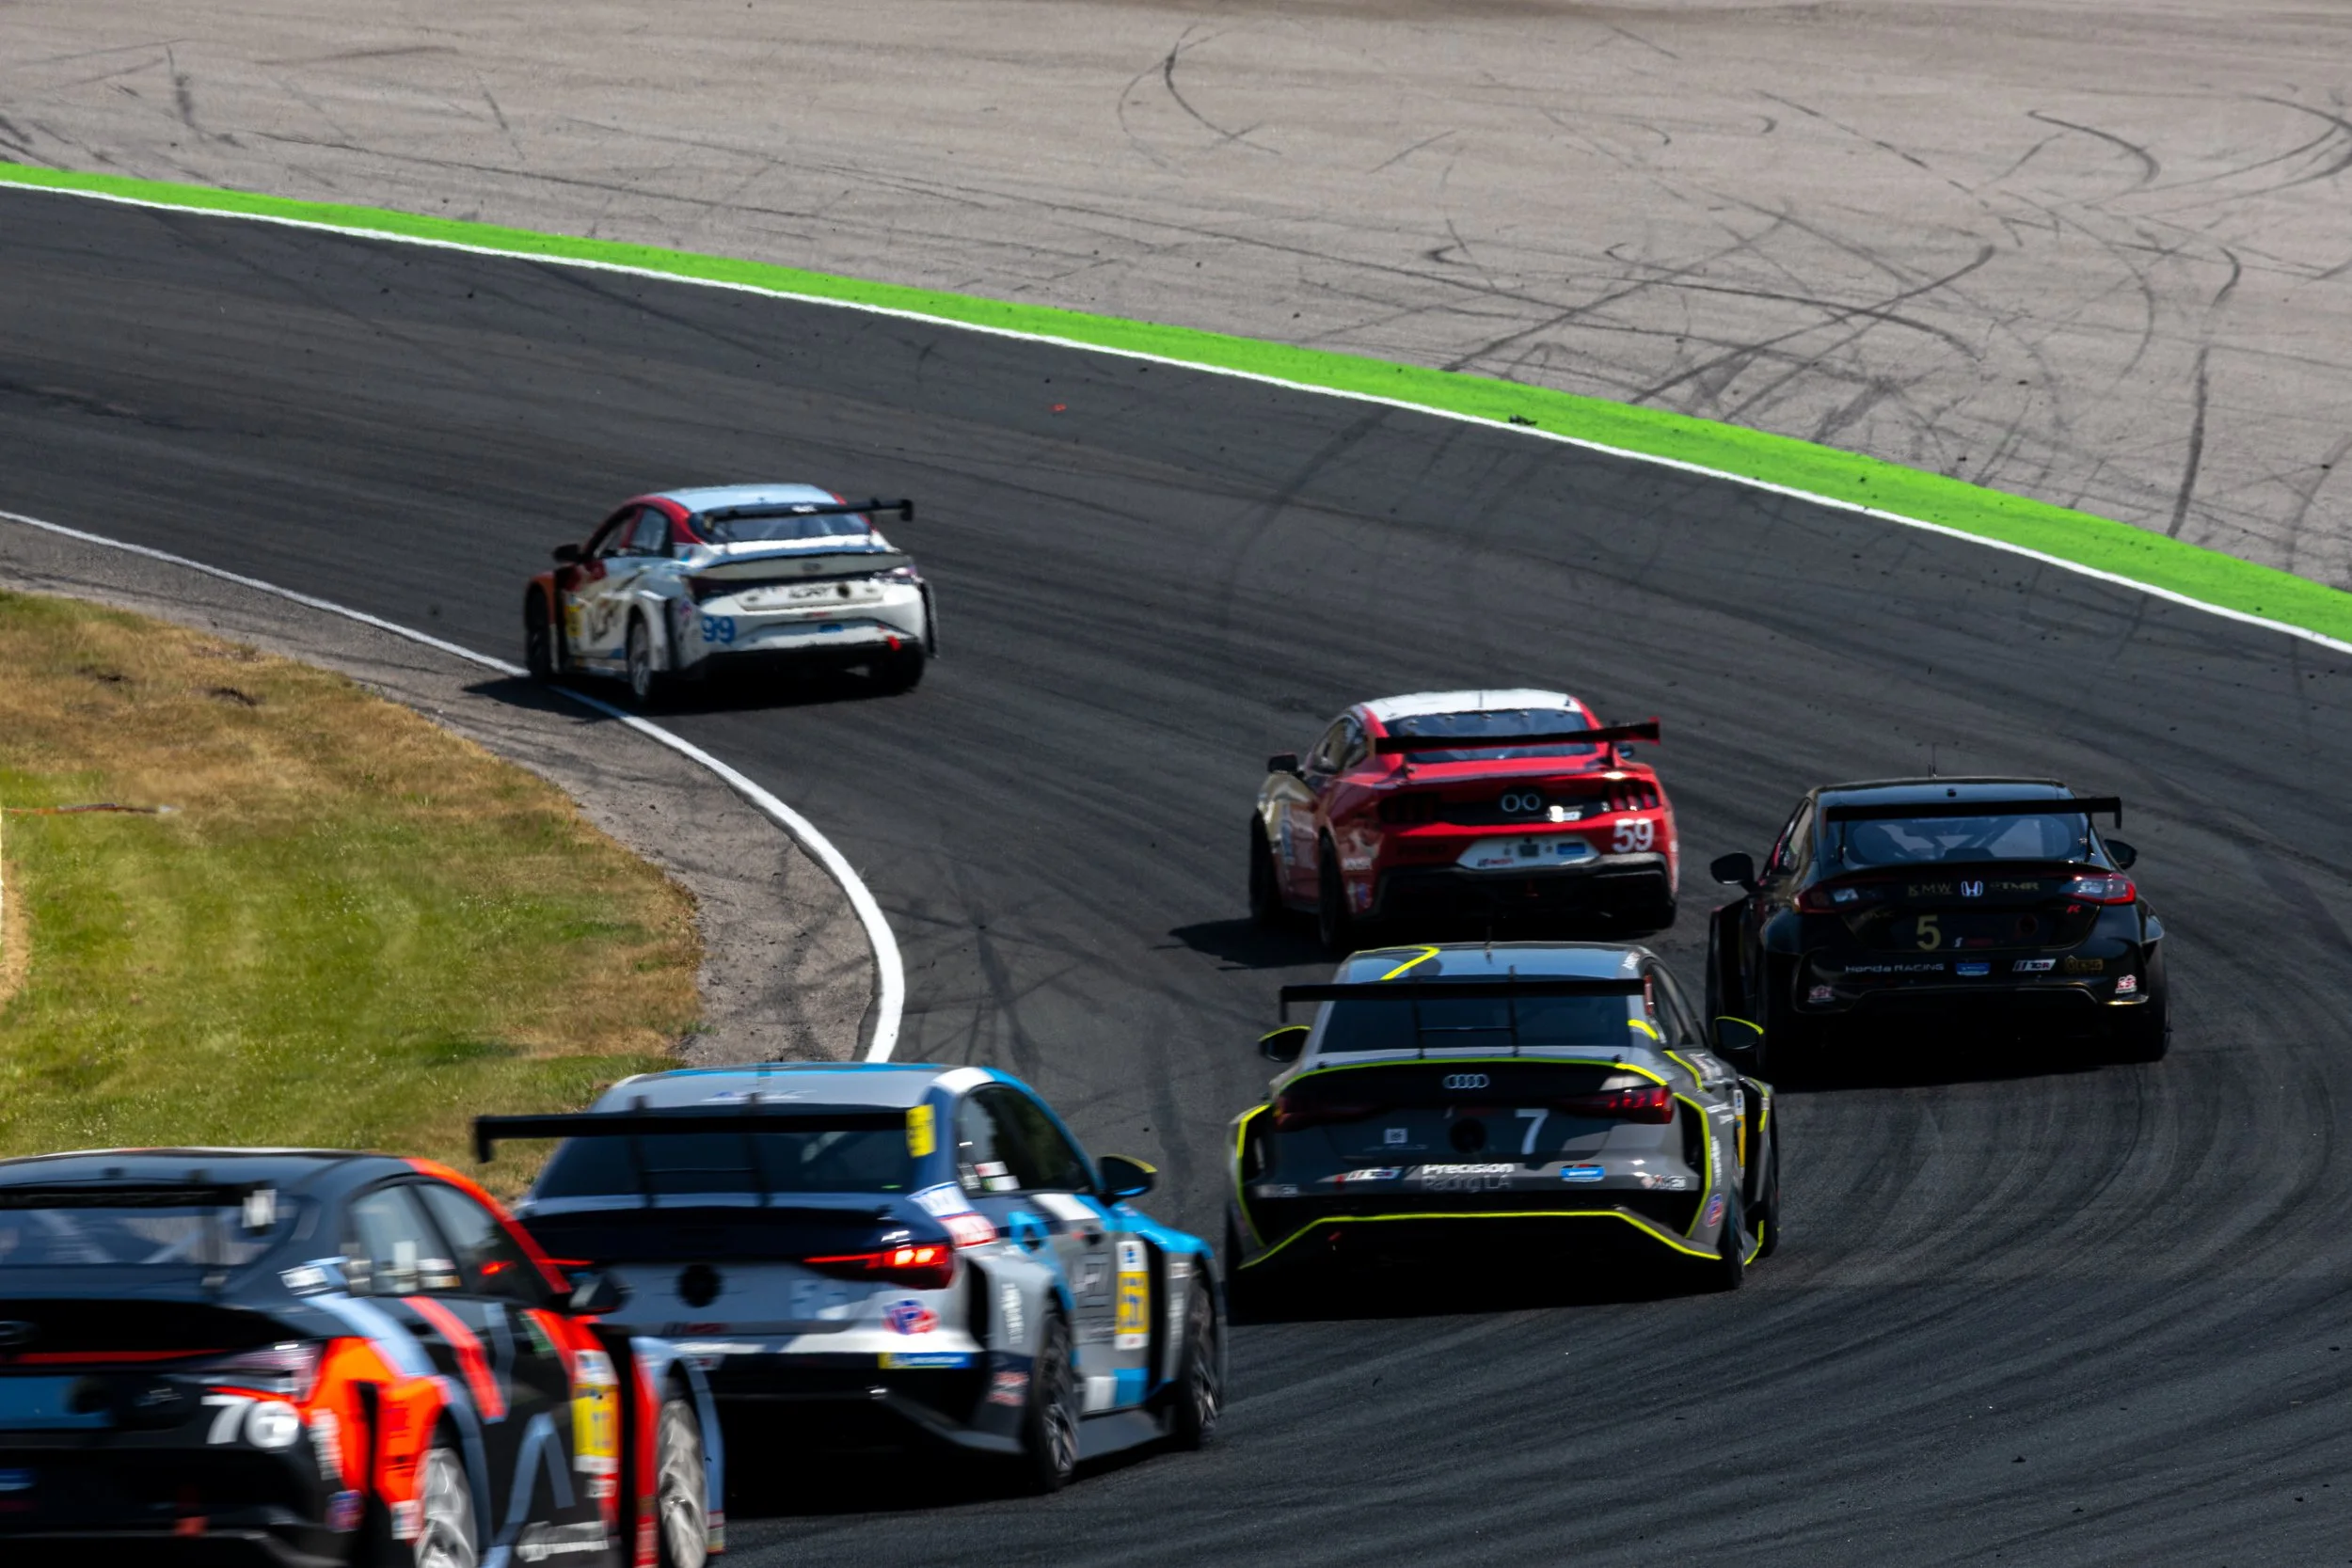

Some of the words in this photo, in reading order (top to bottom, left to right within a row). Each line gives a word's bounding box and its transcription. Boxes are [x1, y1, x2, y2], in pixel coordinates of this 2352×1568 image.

[700, 616, 738, 644] 99
[1612, 818, 1656, 853] 59
[1915, 913, 1942, 951] 5
[1845, 963, 1892, 974] Honda
[1894, 962, 1945, 974] RACING
[1514, 1107, 1550, 1155] 7
[1422, 1163, 1516, 1175] Precision
[200, 1395, 301, 1449] 76
